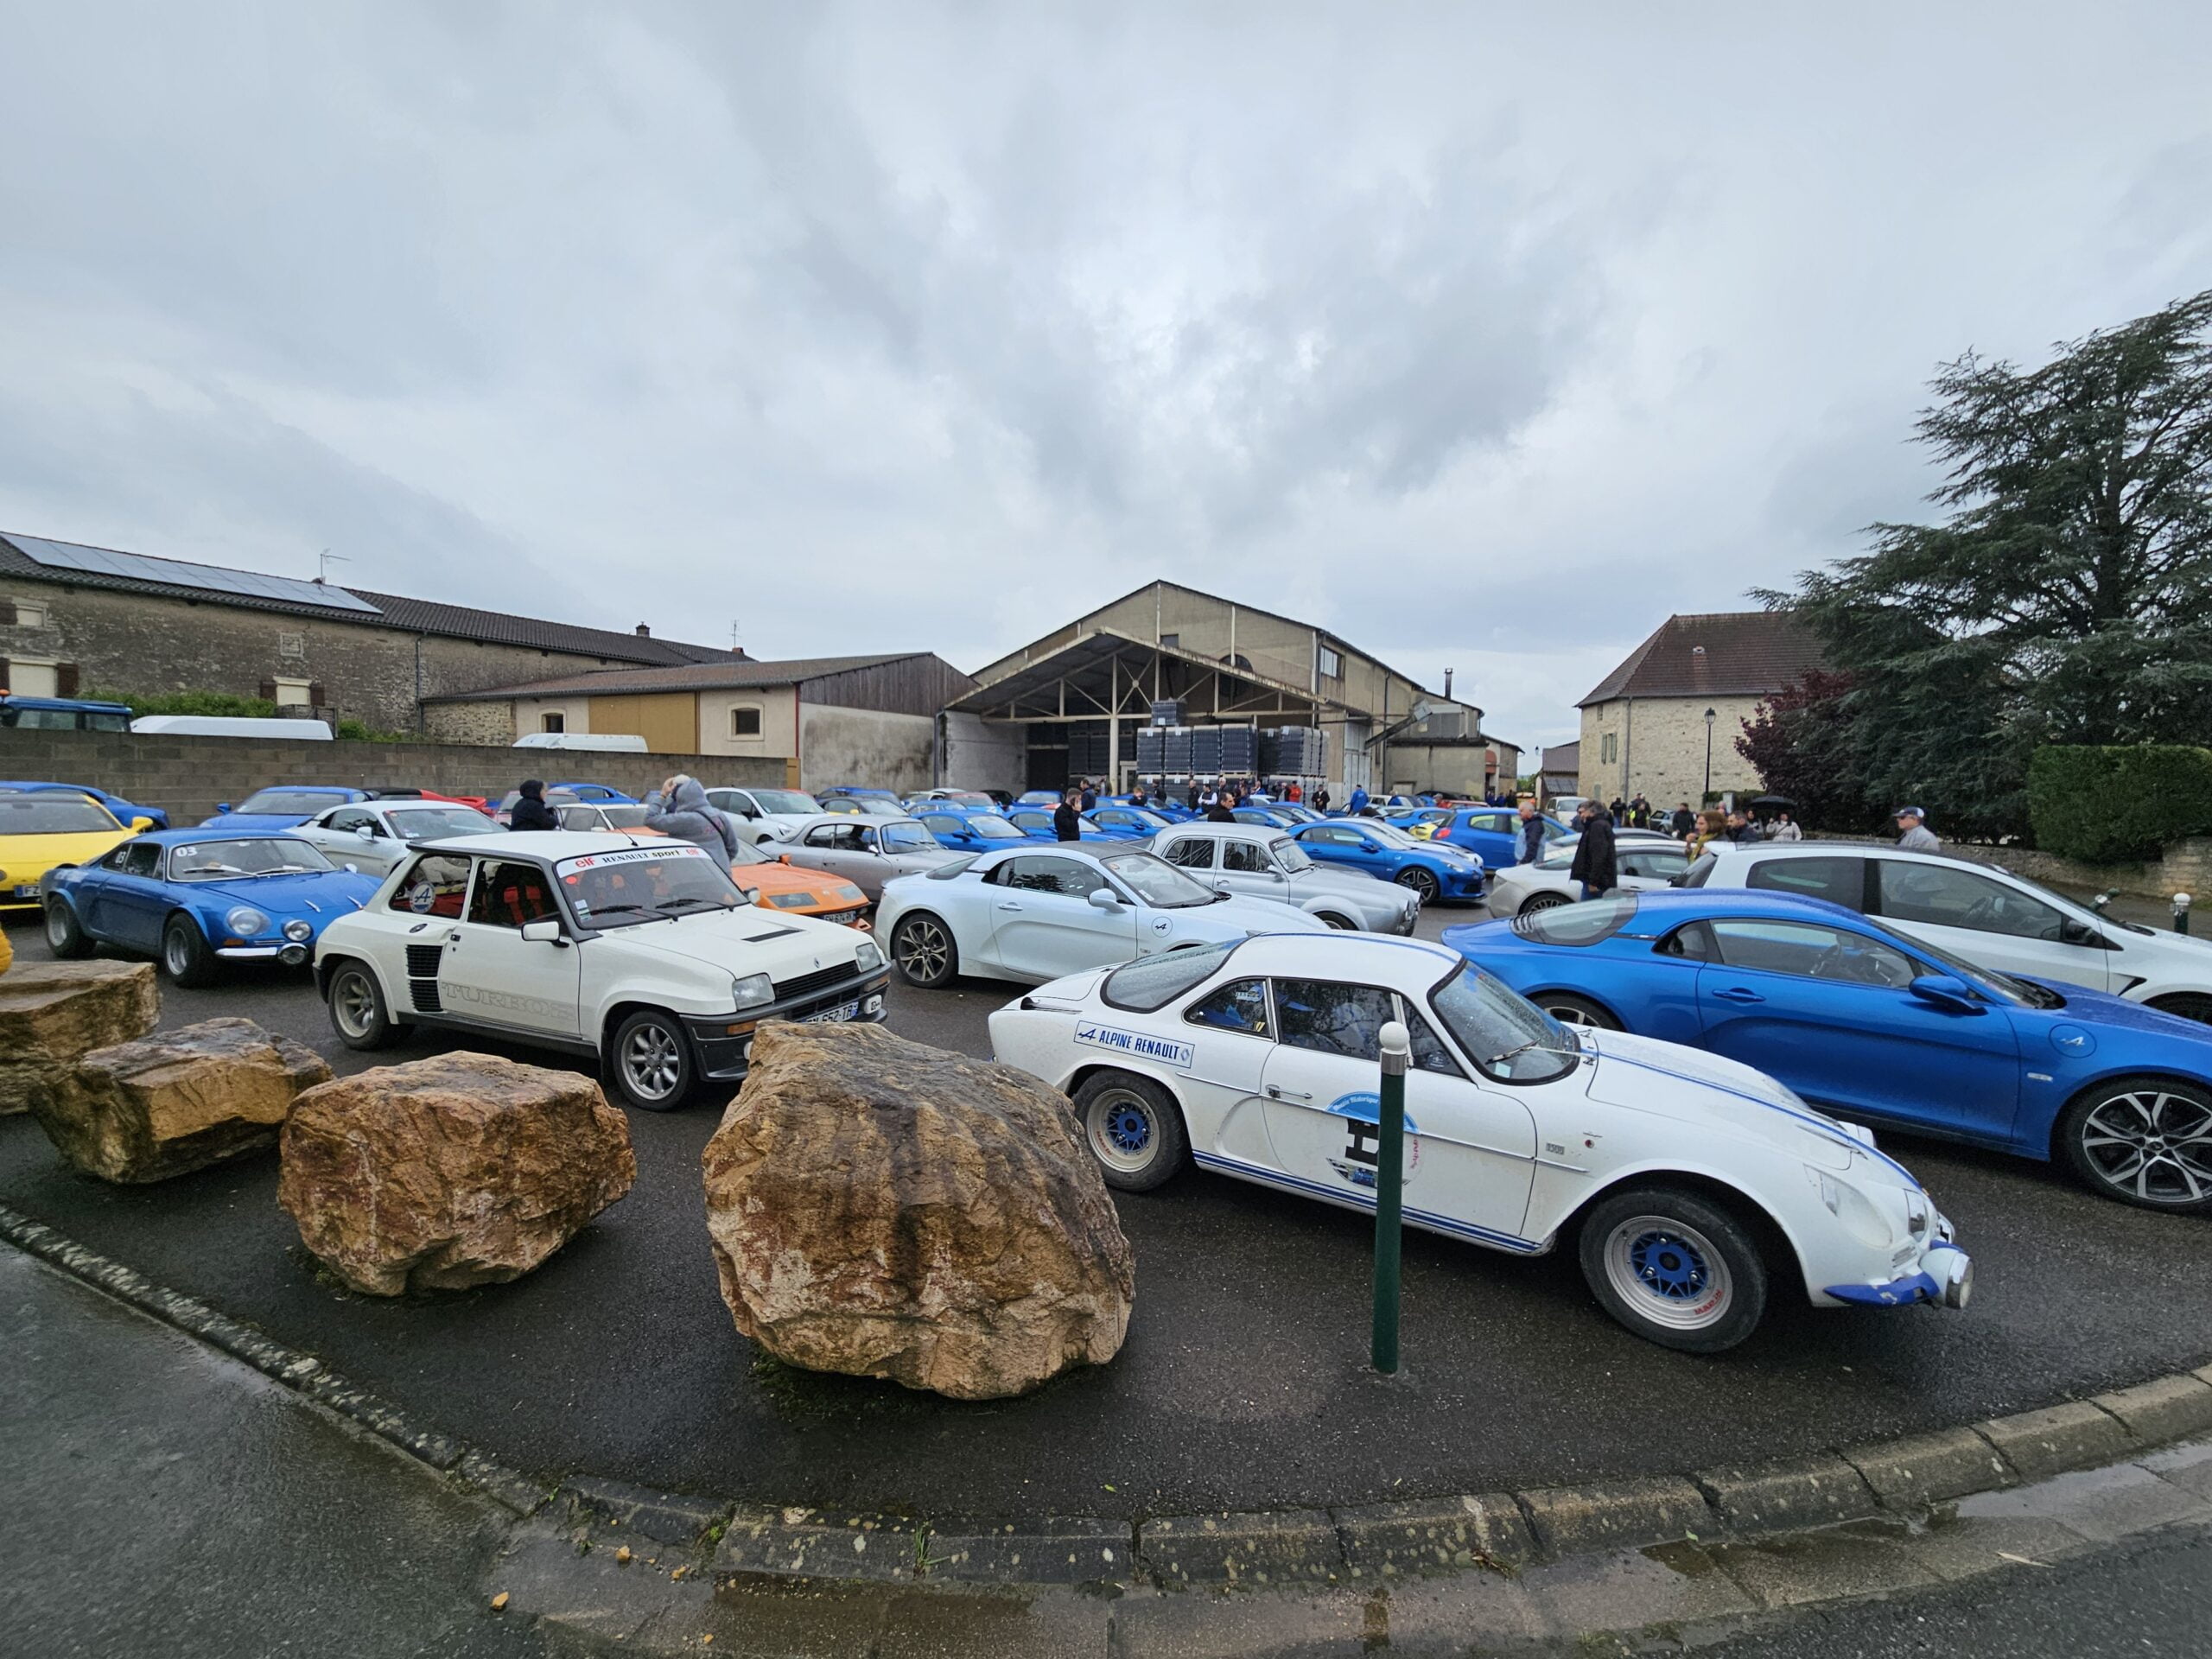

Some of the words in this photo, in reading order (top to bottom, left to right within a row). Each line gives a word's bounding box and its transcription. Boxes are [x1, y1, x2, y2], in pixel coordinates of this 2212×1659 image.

[175, 847, 198, 856] 03
[575, 857, 594, 868] elf
[602, 852, 651, 863] RENAULT
[652, 849, 681, 858] sport
[1099, 1030, 1133, 1049] ALPINE
[1135, 1037, 1180, 1059] RENAULT
